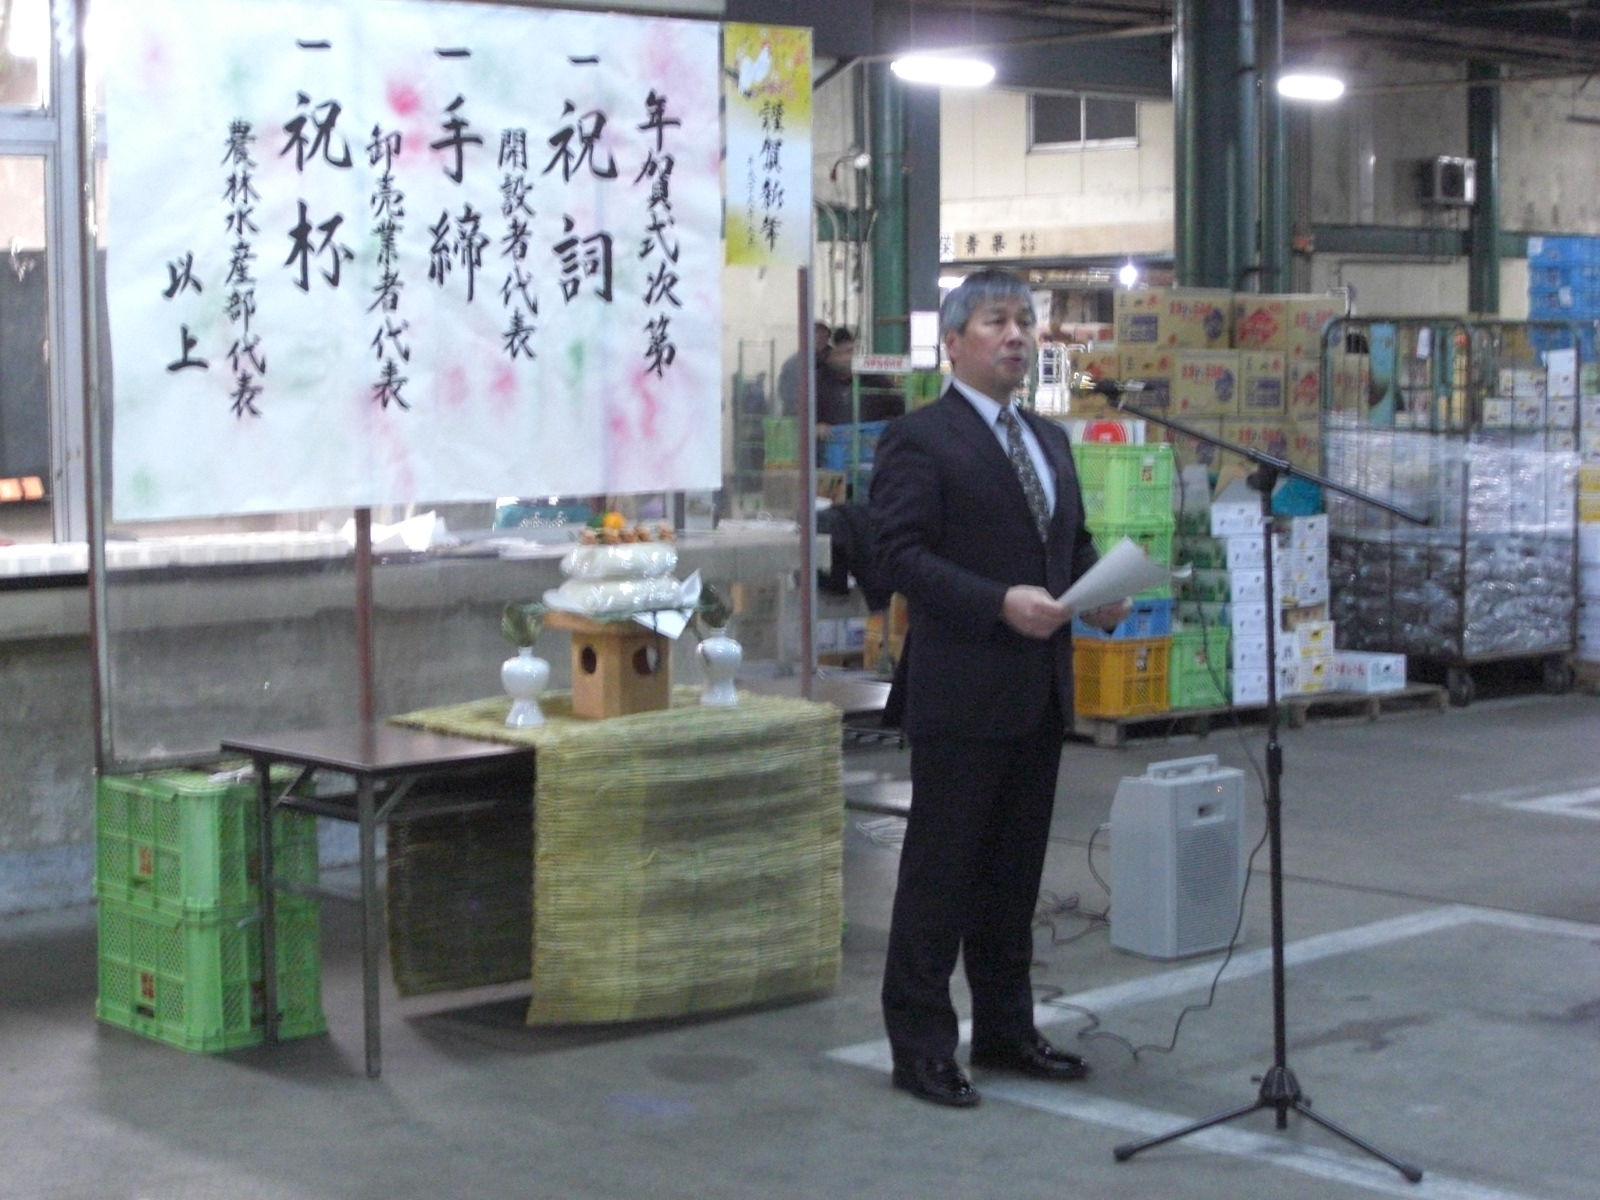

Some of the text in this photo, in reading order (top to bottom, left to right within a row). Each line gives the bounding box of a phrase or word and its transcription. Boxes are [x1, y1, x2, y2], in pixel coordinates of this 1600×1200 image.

[162, 252, 209, 373] 以上
[221, 119, 267, 418] 農林水産部代表
[366, 124, 411, 410] 卸売業者代表
[499, 130, 538, 360] 開設者代表
[634, 89, 682, 378] 年賀式次第
